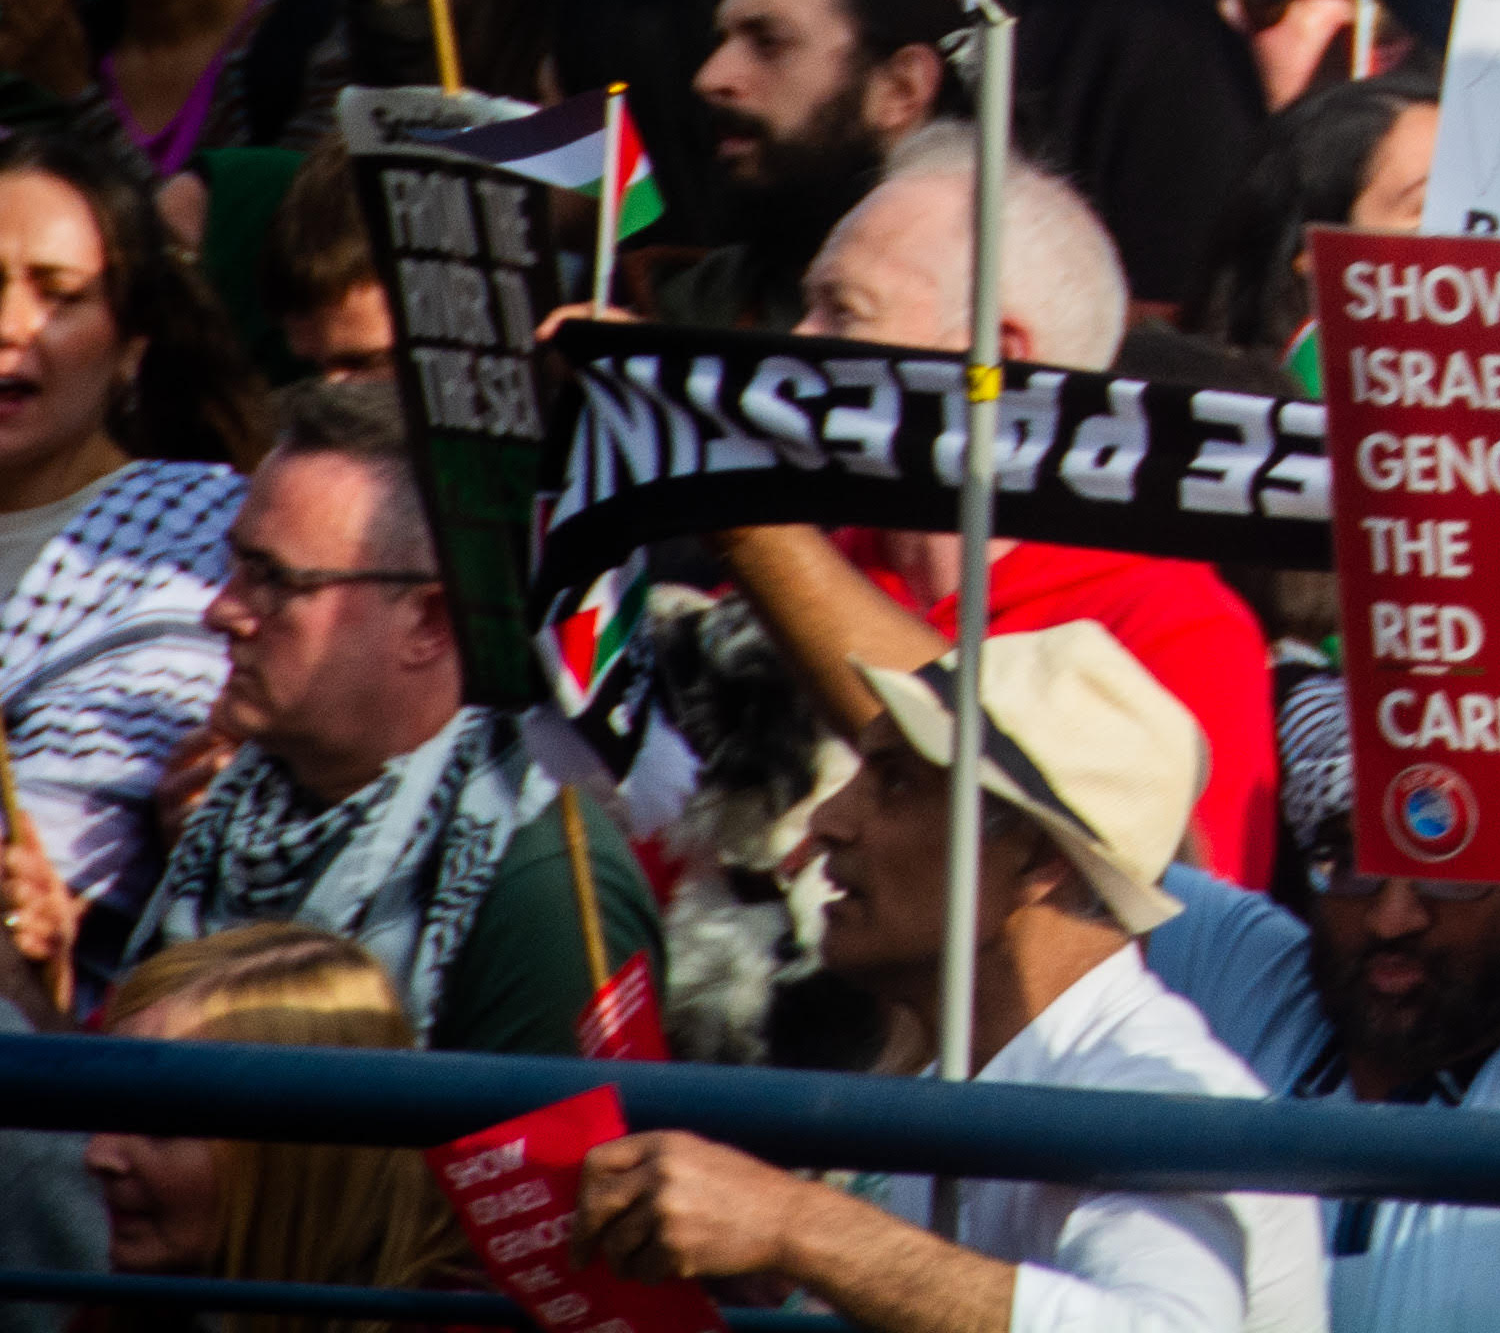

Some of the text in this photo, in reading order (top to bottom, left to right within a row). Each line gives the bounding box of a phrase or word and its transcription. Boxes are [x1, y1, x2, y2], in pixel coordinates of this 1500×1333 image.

[546, 353, 1150, 533] PALESTIN
[1361, 516, 1473, 580] THE
[1370, 600, 1485, 664] RED
